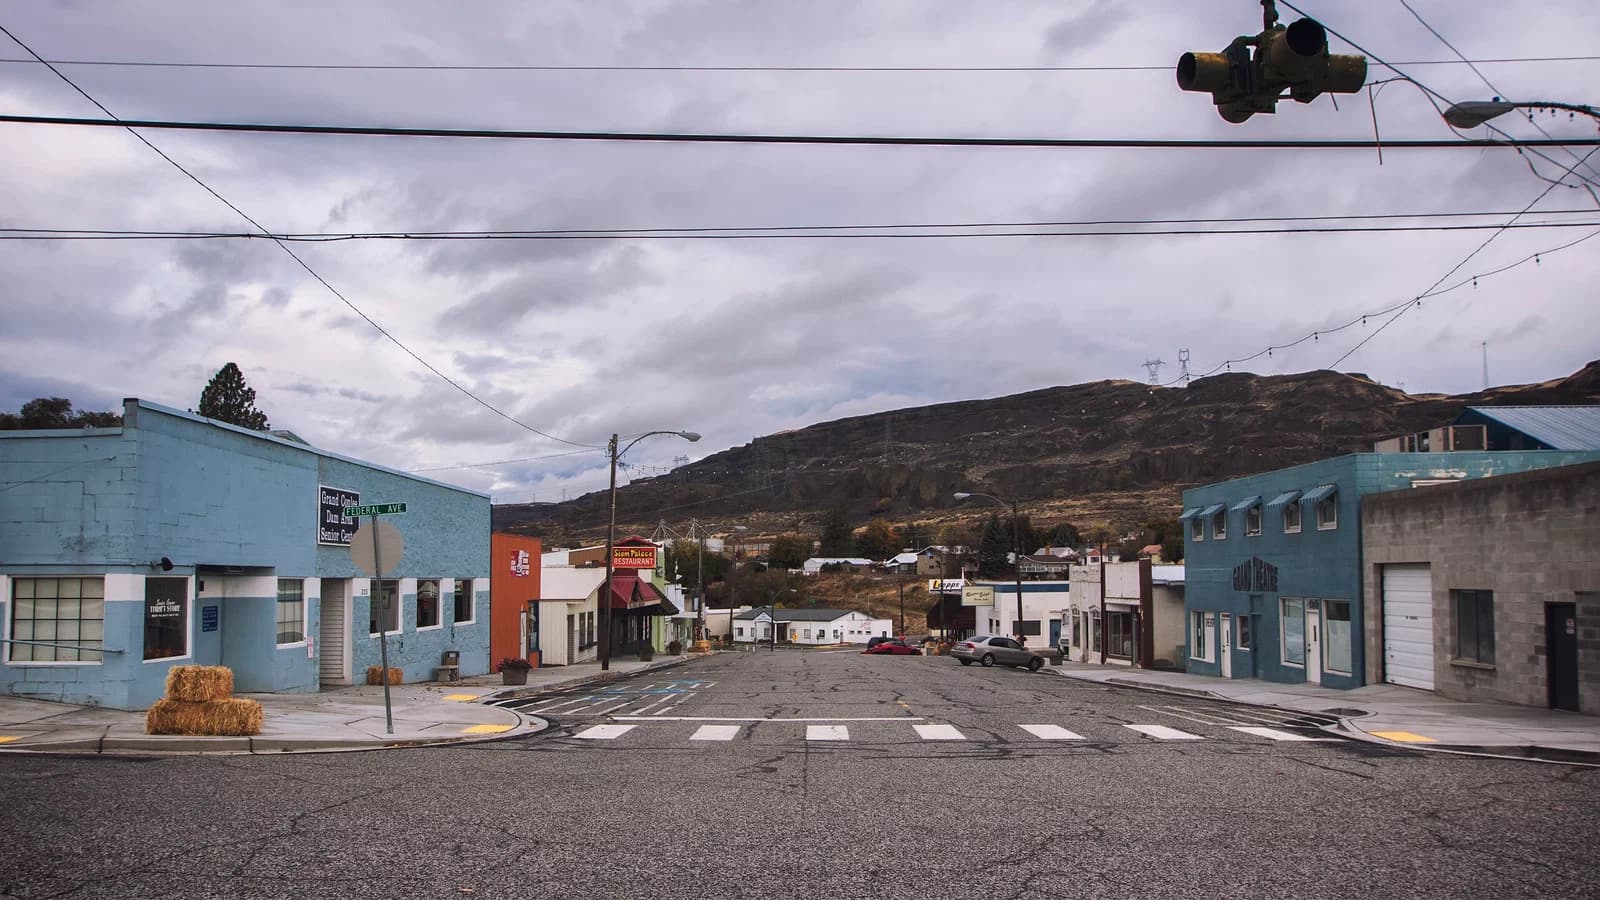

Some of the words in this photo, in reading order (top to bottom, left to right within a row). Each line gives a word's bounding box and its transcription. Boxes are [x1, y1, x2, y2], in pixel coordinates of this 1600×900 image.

[321, 490, 339, 506] Grand
[326, 509, 339, 523] Dam
[346, 506, 381, 516] FEDERAL
[387, 503, 403, 513] AVE
[320, 527, 340, 541] Senior
[341, 529, 353, 542] Cent
[613, 549, 630, 557] Siam
[630, 549, 653, 557] Palace
[613, 557, 654, 565] RESTAURANT
[1232, 559, 1252, 592] GRAND
